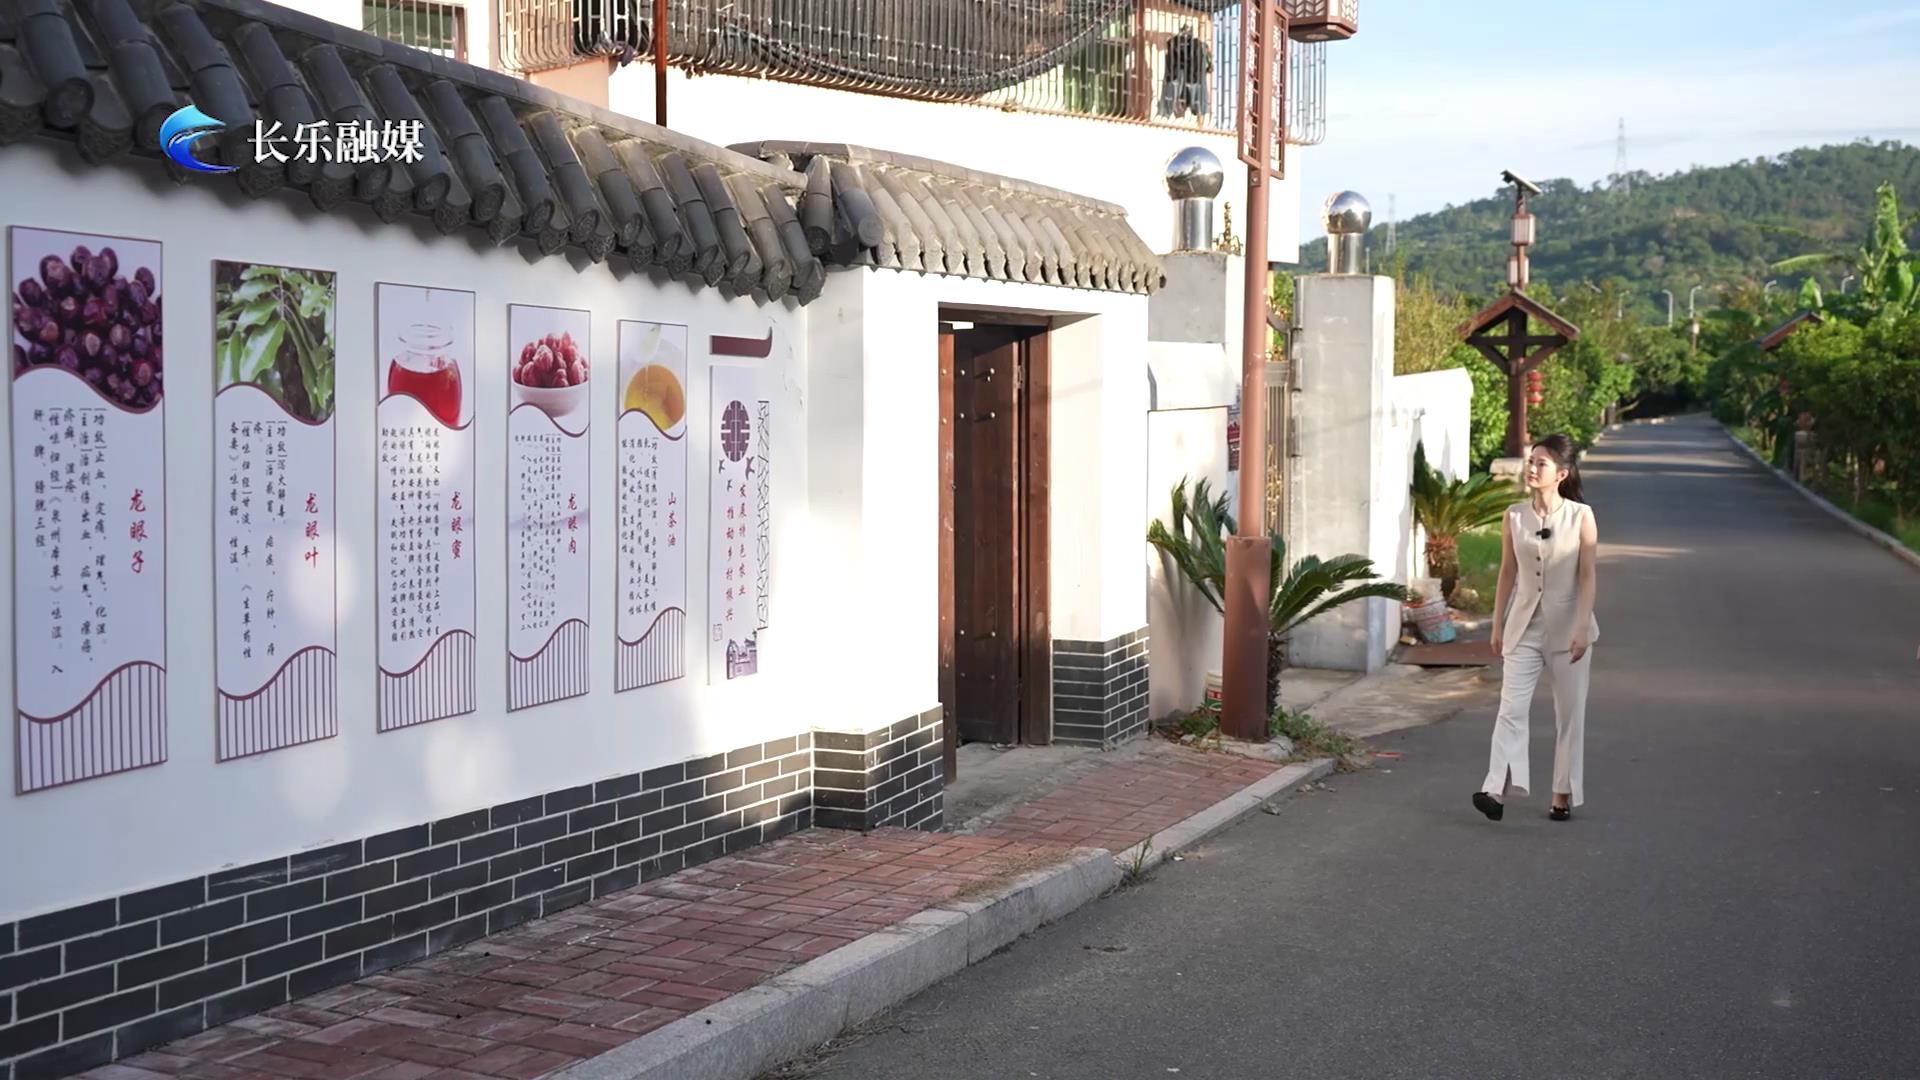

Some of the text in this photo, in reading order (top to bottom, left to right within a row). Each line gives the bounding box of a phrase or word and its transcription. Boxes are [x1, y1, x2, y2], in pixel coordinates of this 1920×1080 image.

[129, 488, 148, 573] 龙眼子
[304, 492, 320, 568] 龙眼叶
[451, 491, 463, 559] 龙眼蜜
[568, 493, 578, 554] 龙眼肉
[667, 492, 677, 546] 山茶油
[738, 483, 746, 596] 发展特色农业
[725, 505, 735, 621] 推动乡村振兴
